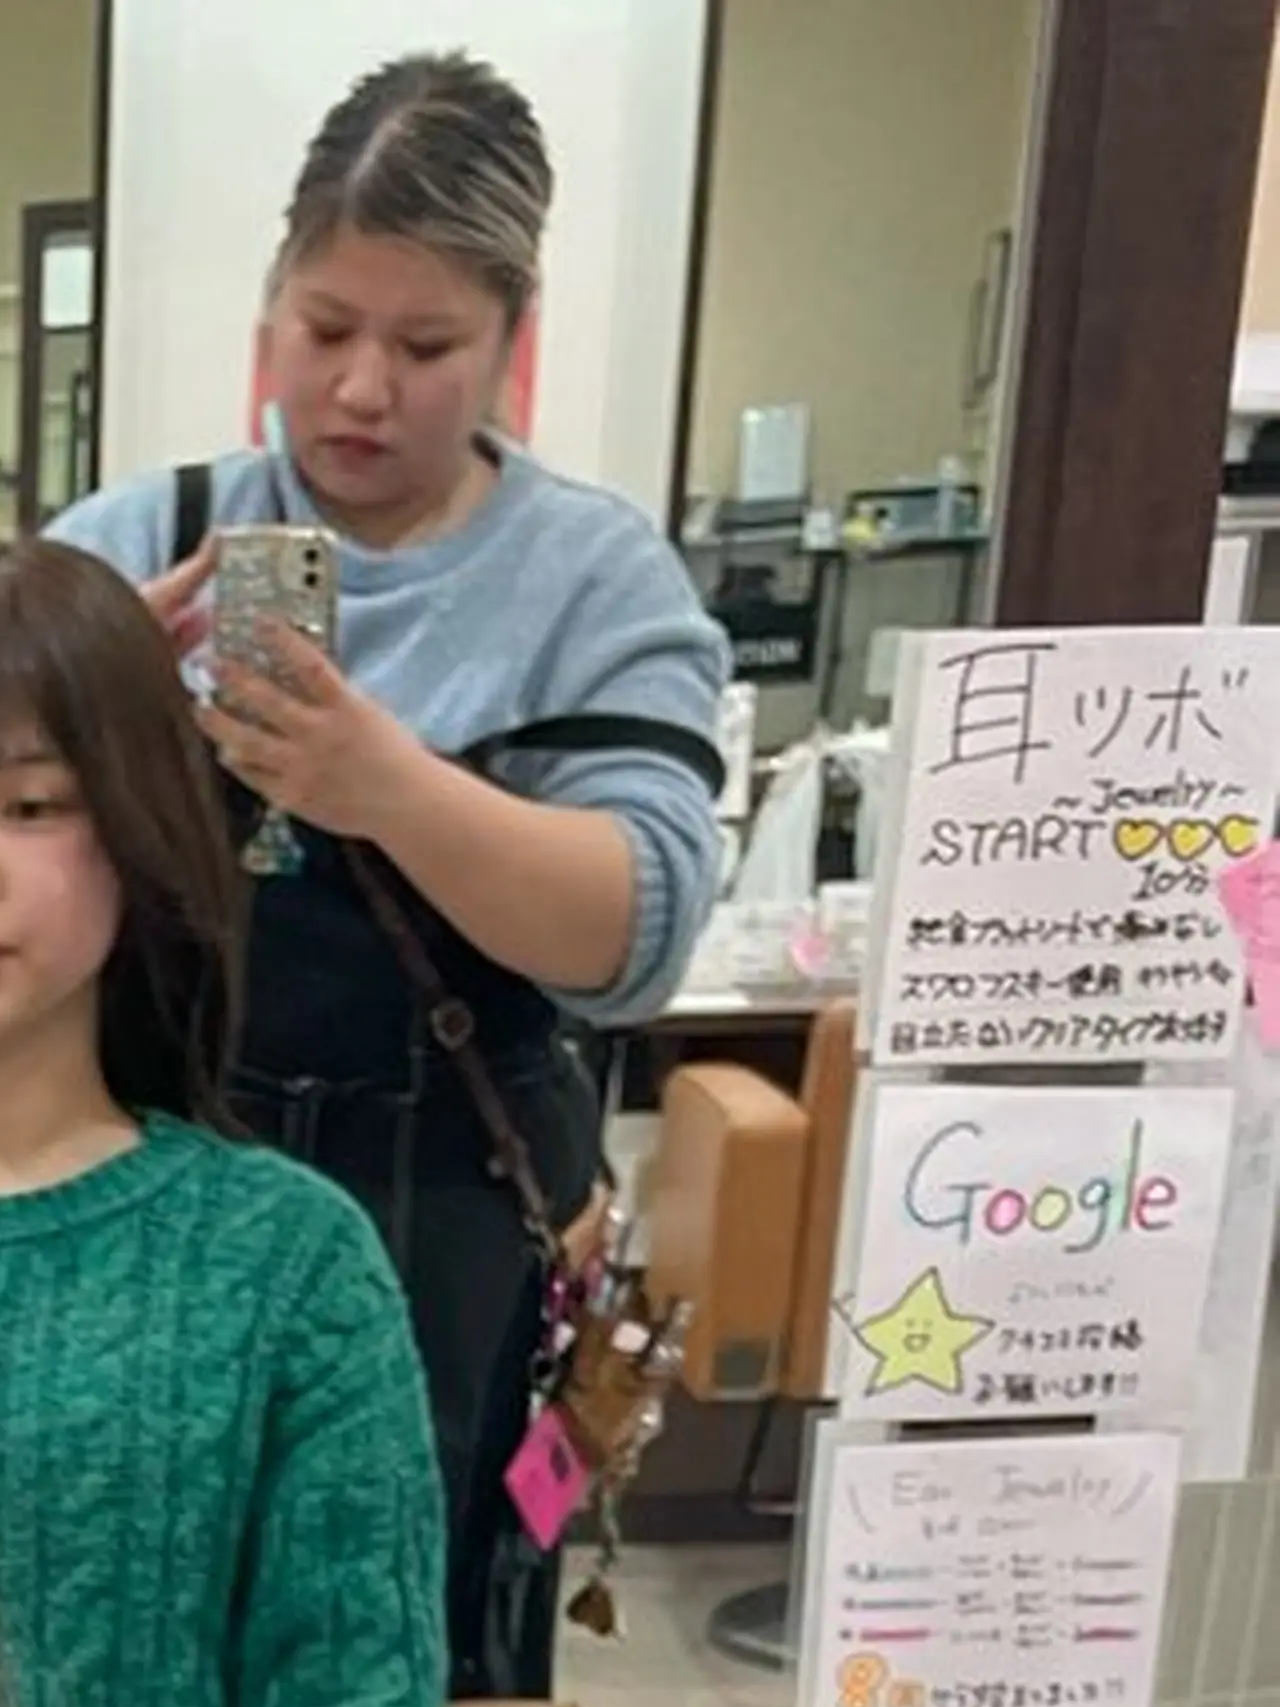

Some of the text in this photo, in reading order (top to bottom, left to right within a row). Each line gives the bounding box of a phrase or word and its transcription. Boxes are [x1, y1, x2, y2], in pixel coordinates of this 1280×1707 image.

[928, 641, 1249, 784] 耳ツボ
[920, 814, 1107, 866] START
[904, 1116, 1178, 1255] Google
